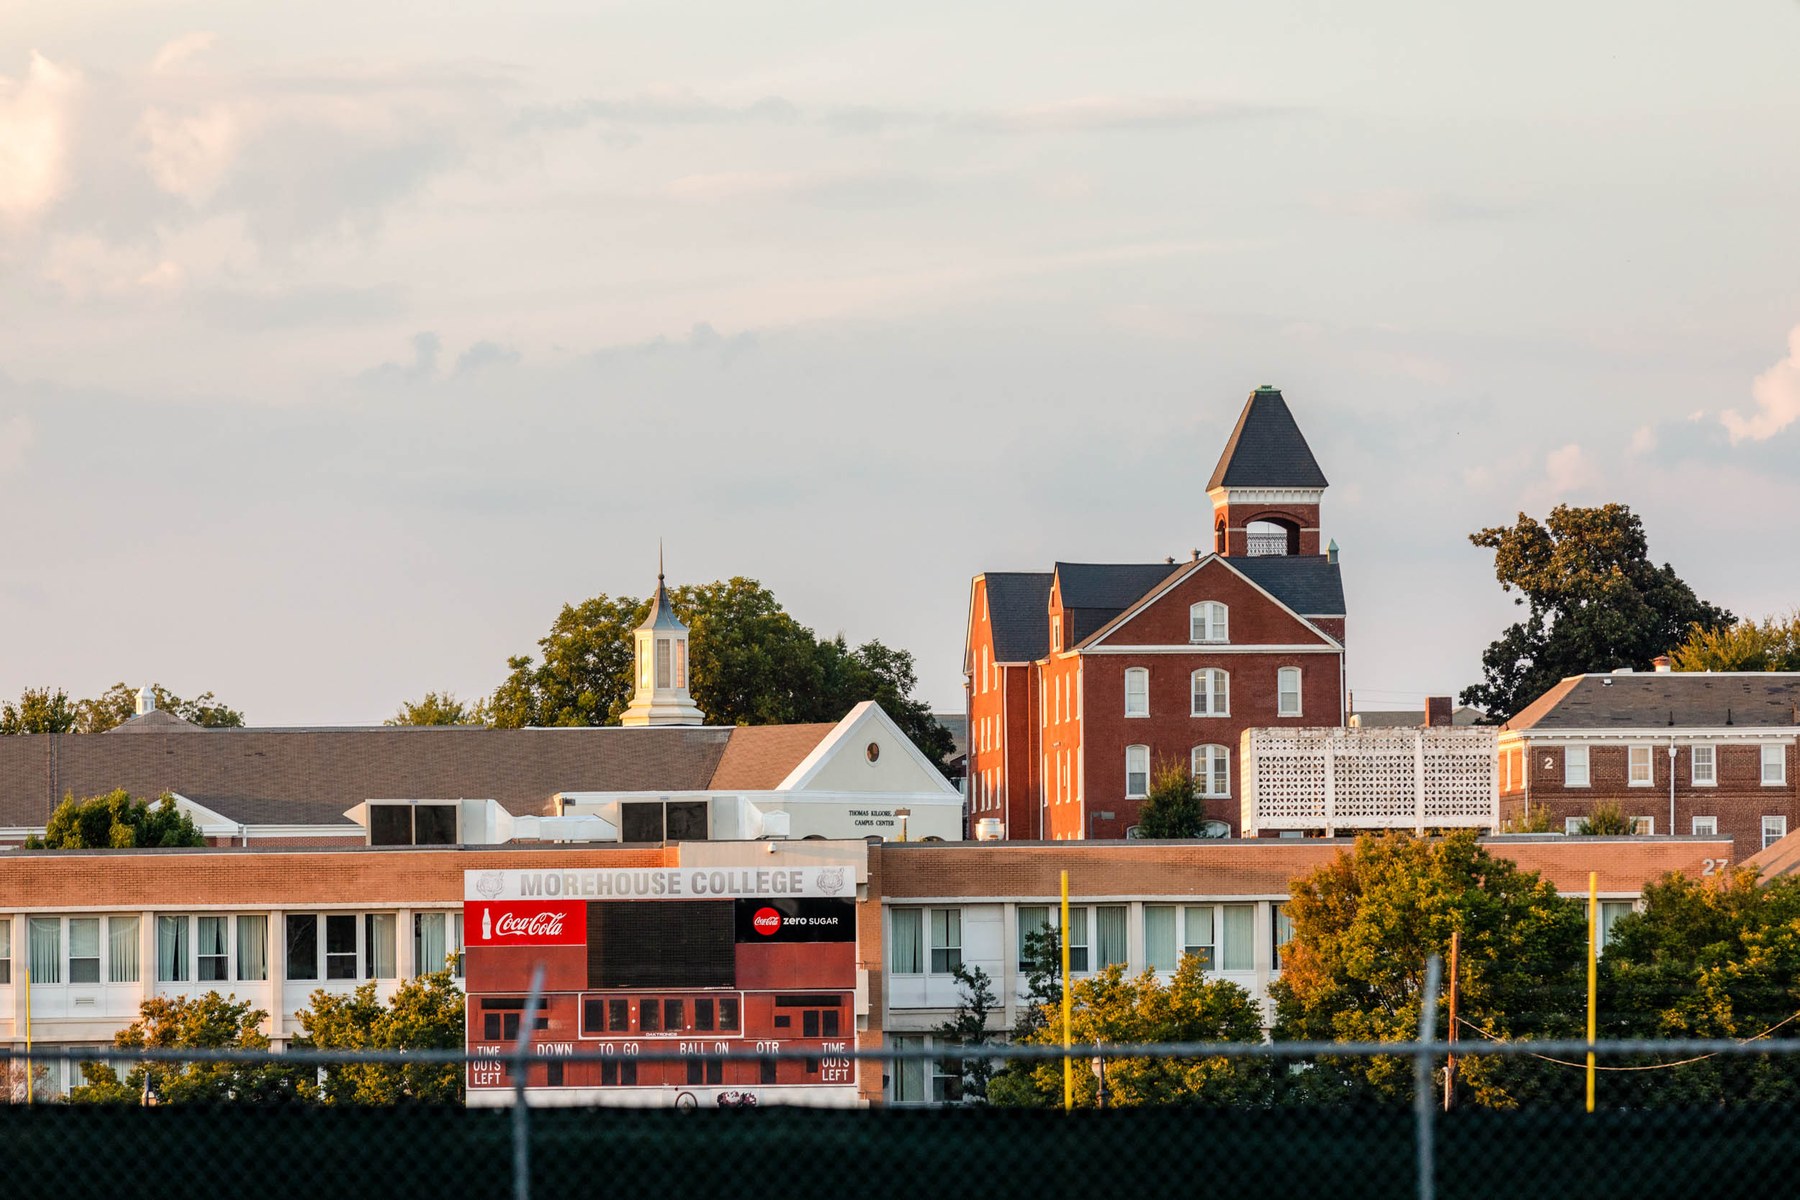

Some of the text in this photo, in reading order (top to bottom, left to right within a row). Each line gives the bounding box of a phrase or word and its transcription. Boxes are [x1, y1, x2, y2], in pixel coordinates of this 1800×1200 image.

[1544, 757, 1553, 769] 2
[1702, 859, 1728, 876] 27
[520, 871, 803, 896] MOREHOUSE COLLEGE
[495, 912, 567, 936] Coca-Cola
[783, 917, 839, 925] zero SUGAR
[477, 1046, 501, 1057] TIME
[537, 1043, 573, 1056] DOWN
[599, 1043, 639, 1056] TO GO
[680, 1042, 729, 1055] BALL ON
[822, 1043, 846, 1054] TIME
[473, 1060, 501, 1072] OUTS
[822, 1057, 850, 1068] OUTS
[474, 1073, 501, 1085] LEFT
[822, 1069, 848, 1081] LEFT
